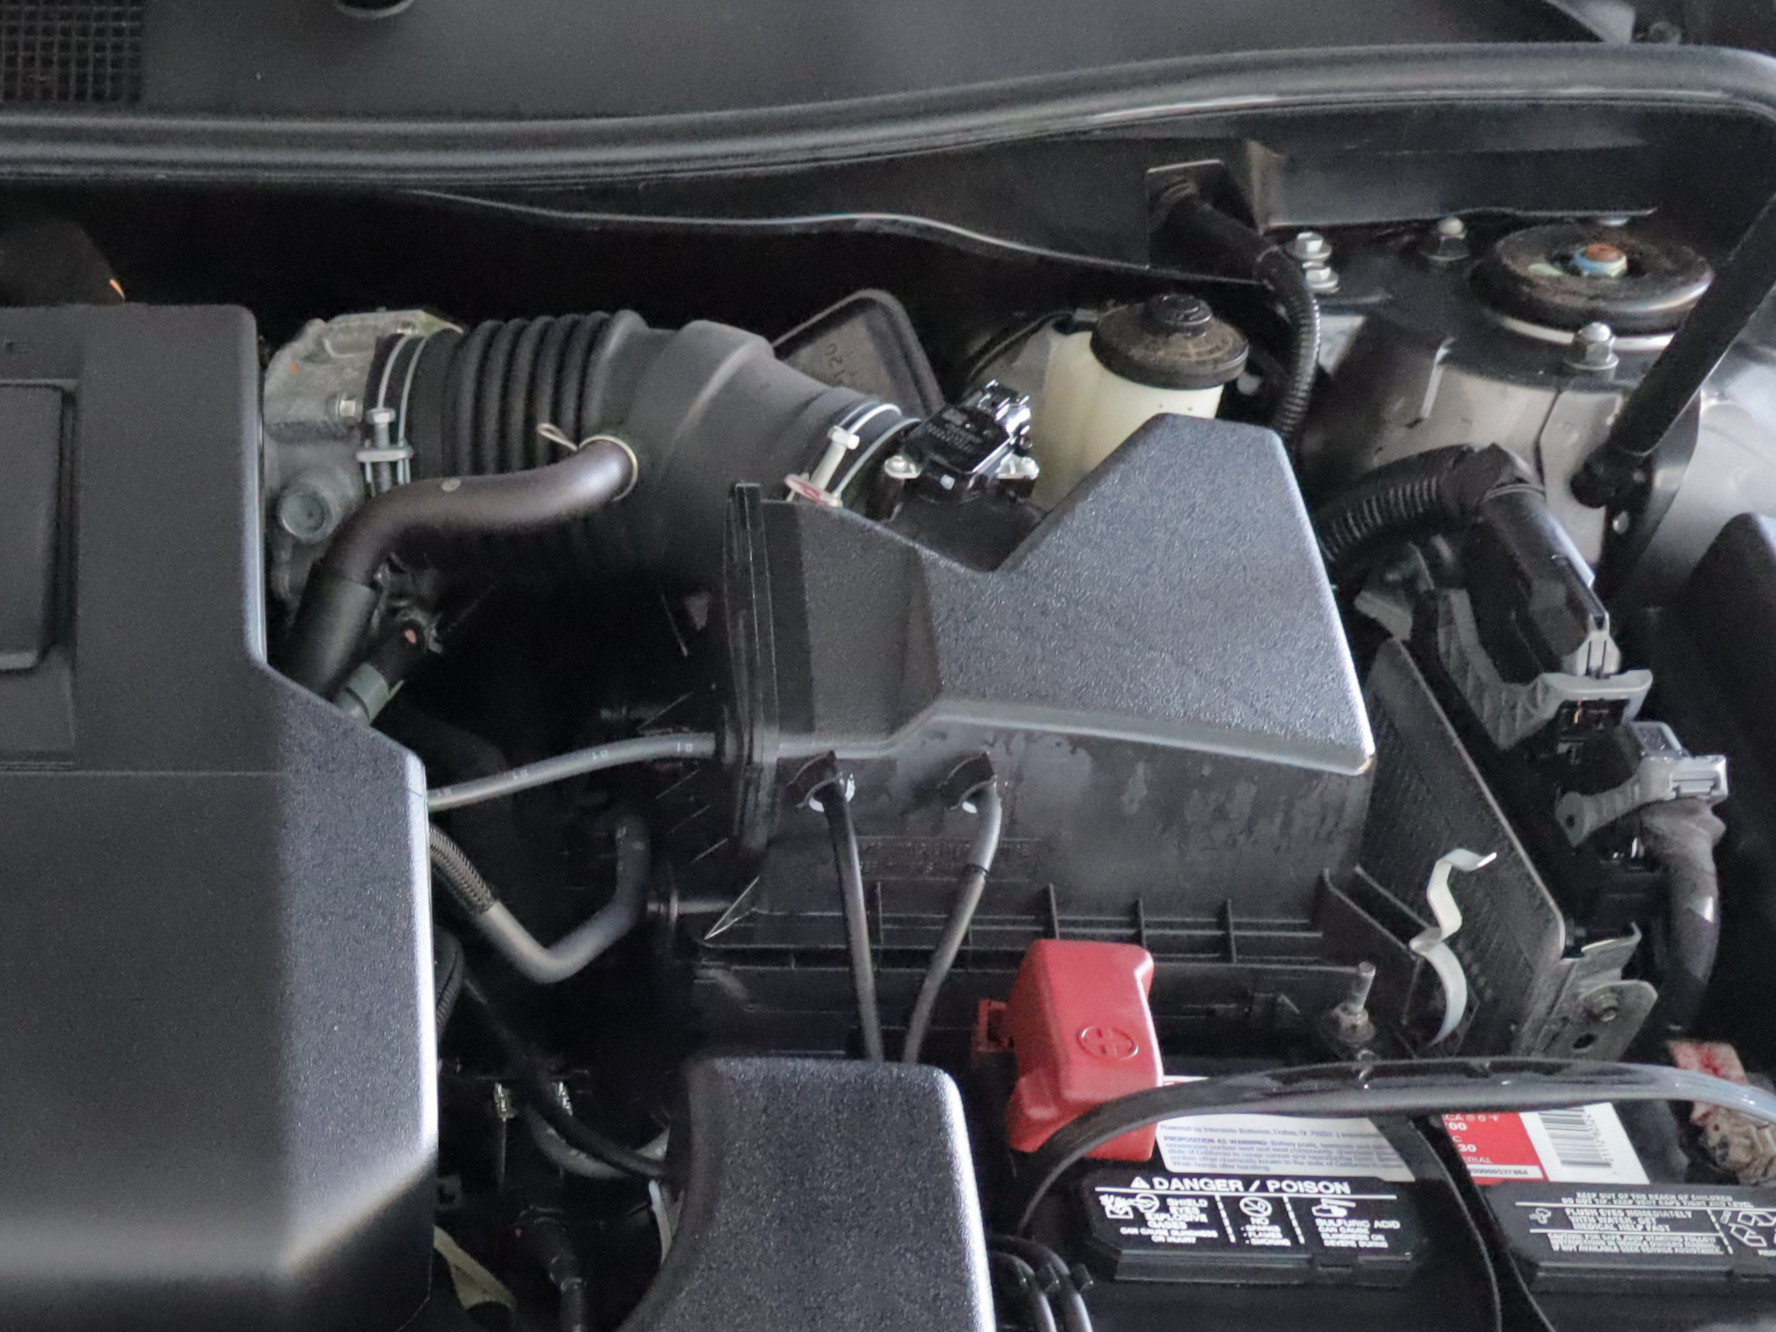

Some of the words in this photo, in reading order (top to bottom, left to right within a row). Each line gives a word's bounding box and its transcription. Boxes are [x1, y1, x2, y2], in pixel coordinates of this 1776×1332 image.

[1445, 1122, 1468, 1131] 00
[1152, 1177, 1244, 1192] DANGER
[1266, 1180, 1351, 1194] POISON
[1166, 1198, 1208, 1208] SHIELD
[1168, 1206, 1201, 1215] EYES
[1144, 1212, 1209, 1223] EXPLOSIVE
[1250, 1217, 1270, 1225] NO
[1315, 1218, 1371, 1228] SULFURIC
[1374, 1219, 1401, 1229] ACID
